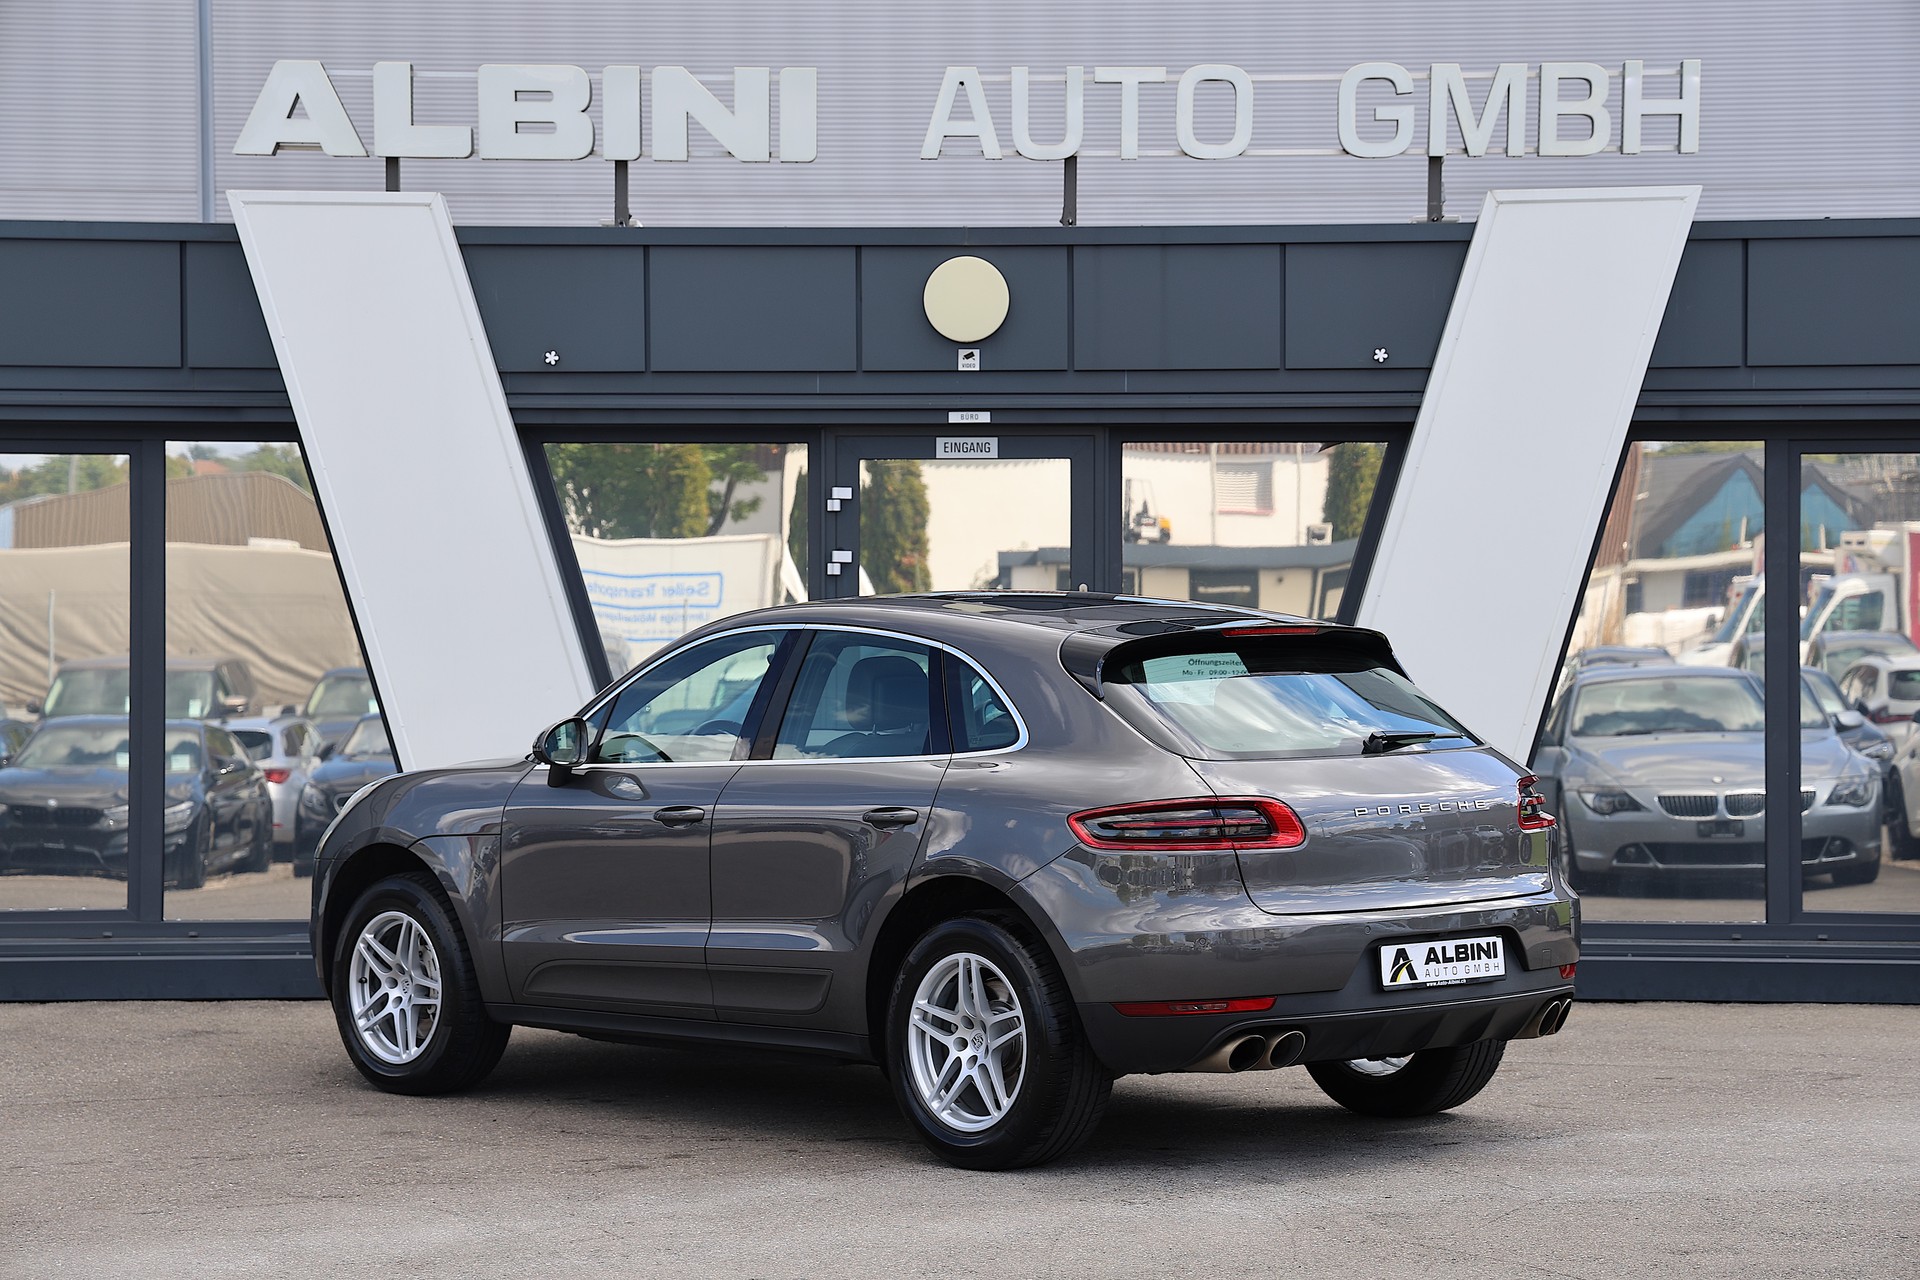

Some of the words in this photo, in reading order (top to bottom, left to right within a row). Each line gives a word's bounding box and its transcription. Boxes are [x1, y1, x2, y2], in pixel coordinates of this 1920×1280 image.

[232, 59, 818, 162] ALBINI
[920, 63, 1254, 161] AUTO
[1337, 58, 1702, 160] GMBH
[960, 413, 980, 421] BÜRO
[943, 441, 992, 454] EINGANG
[1354, 799, 1490, 817] PORSCHE
[1424, 941, 1499, 966] ALBINI
[1424, 966, 1459, 978] AUTO
[1464, 962, 1501, 975] GMBH
